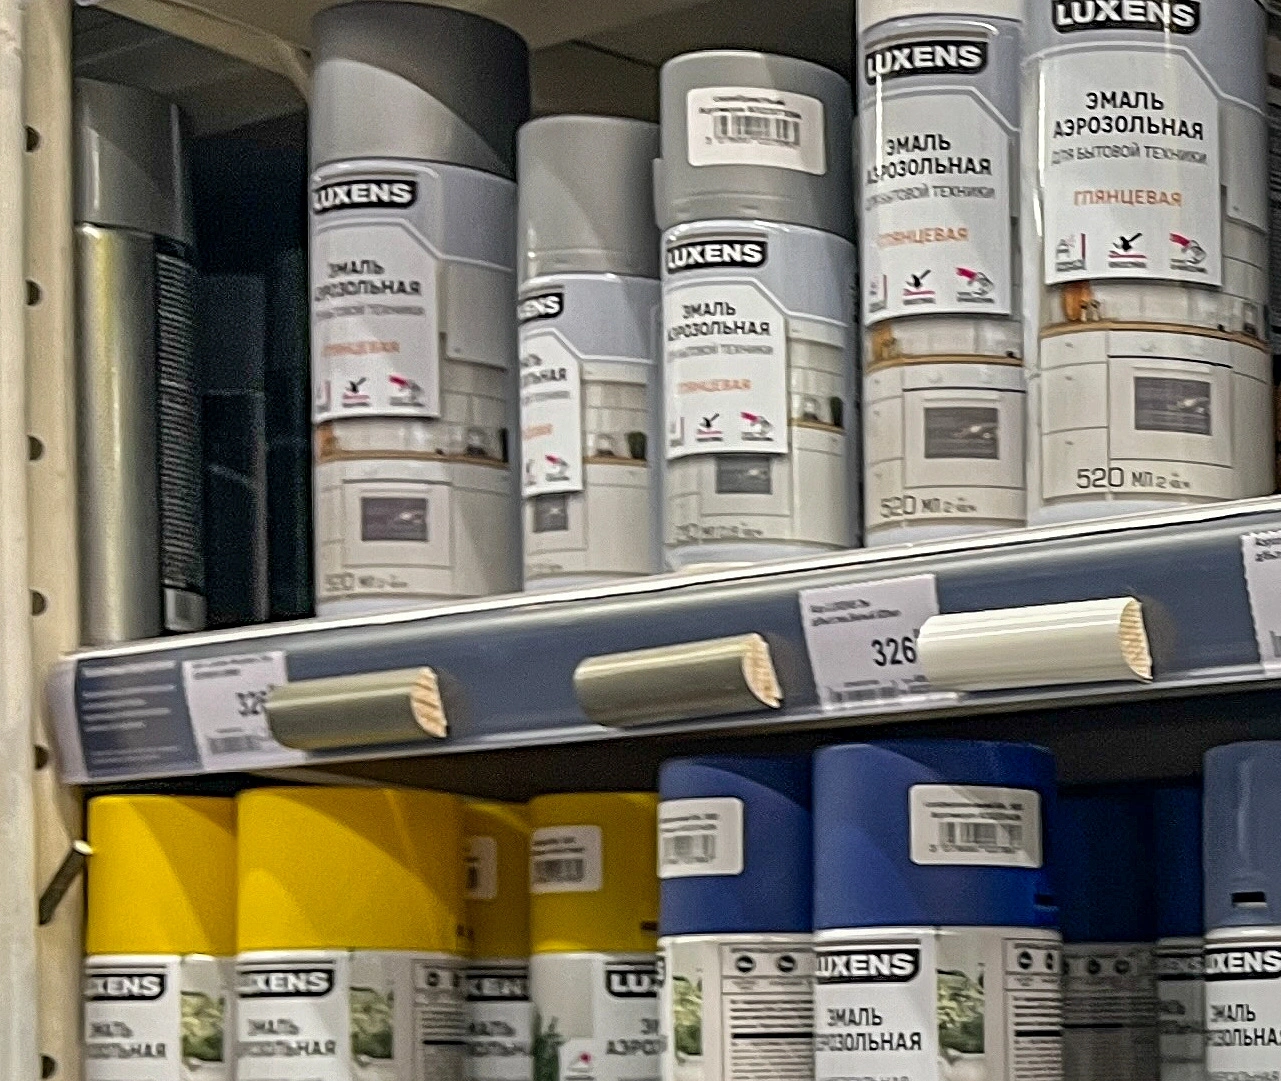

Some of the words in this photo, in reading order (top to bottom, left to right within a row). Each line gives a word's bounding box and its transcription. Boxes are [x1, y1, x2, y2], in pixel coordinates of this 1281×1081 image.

[1056, 0, 1196, 28] LUXENS
[866, 45, 982, 78] LUXENS
[1085, 91, 1164, 111] ЭМАЛЬ
[1053, 116, 1205, 141] АЭРОЗОЛЬНАЯ
[886, 134, 952, 156] ЭМАЛЬ
[1074, 189, 1184, 208] ГЛЯНЦЕВАЯ
[1076, 467, 1125, 489] 520
[871, 636, 917, 667] 326
